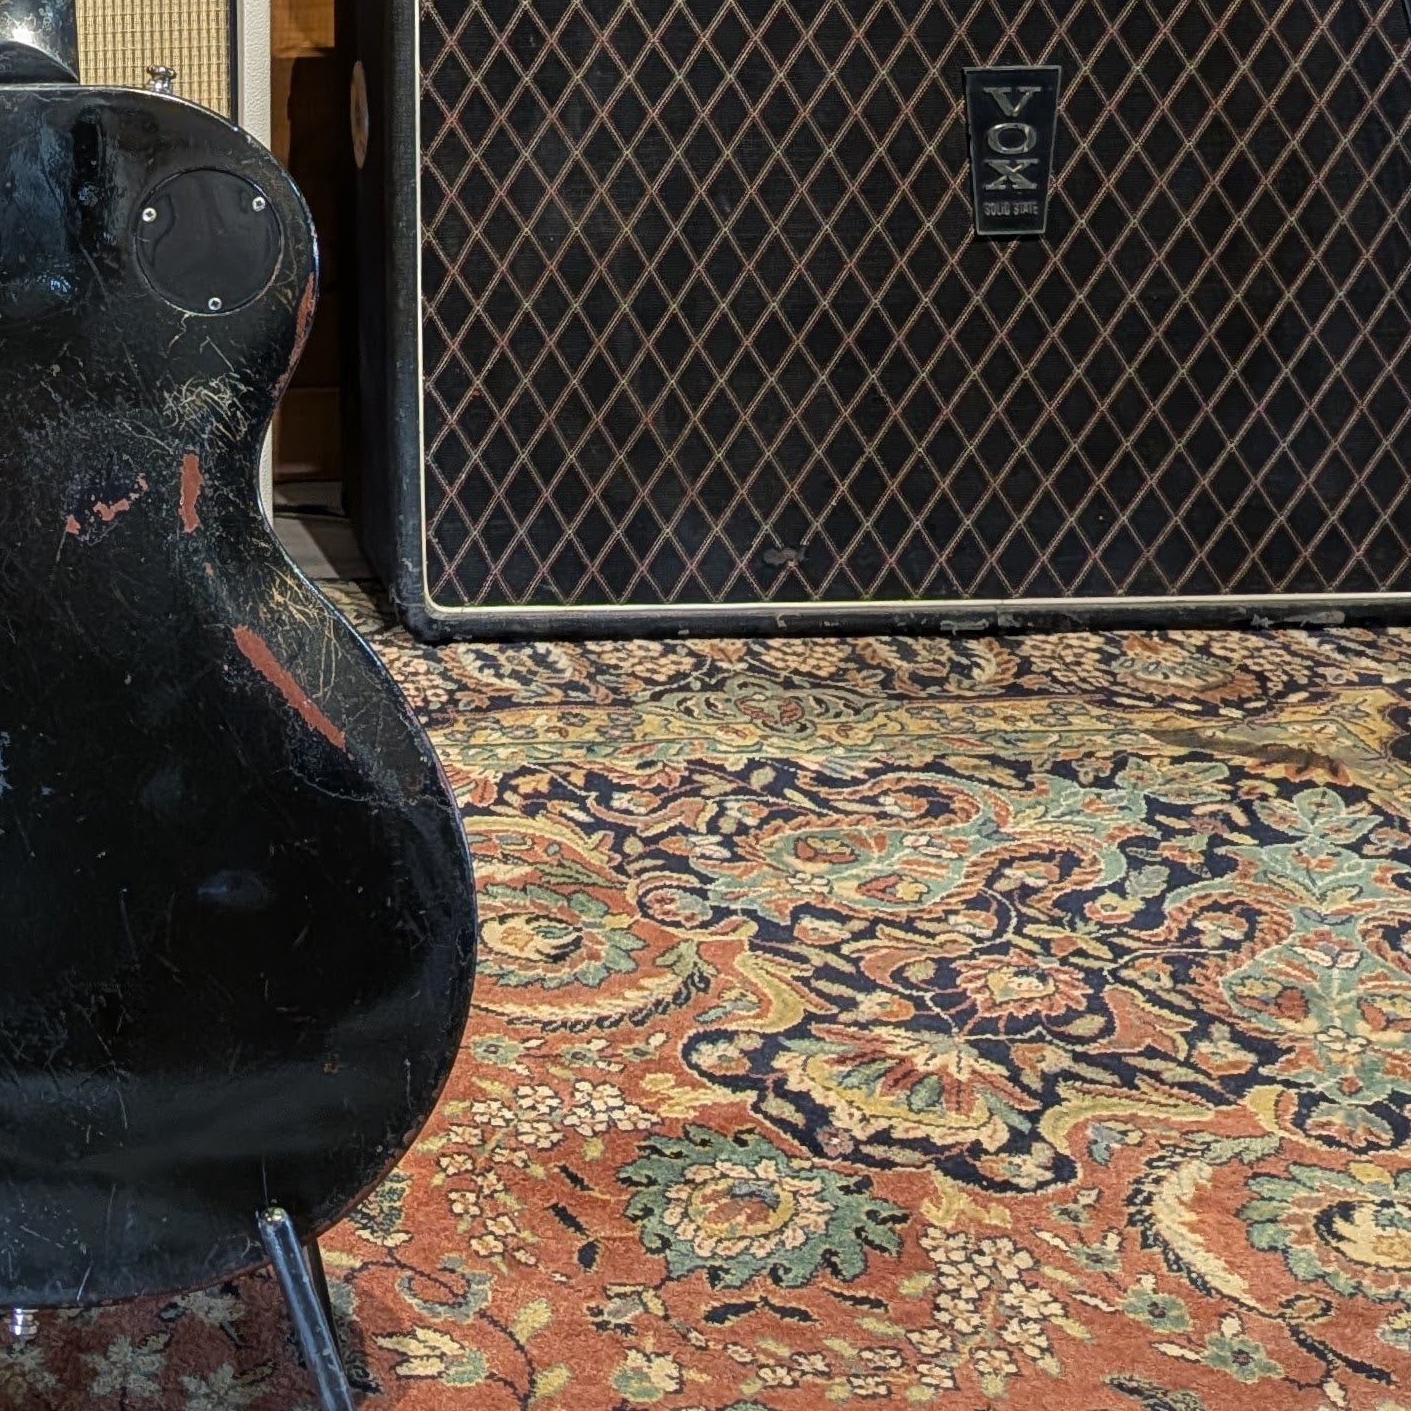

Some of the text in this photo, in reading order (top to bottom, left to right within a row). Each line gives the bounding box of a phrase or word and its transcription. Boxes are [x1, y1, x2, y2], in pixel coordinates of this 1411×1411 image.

[982, 85, 1042, 191] VOX
[984, 201, 1039, 217] SOLID STATE
